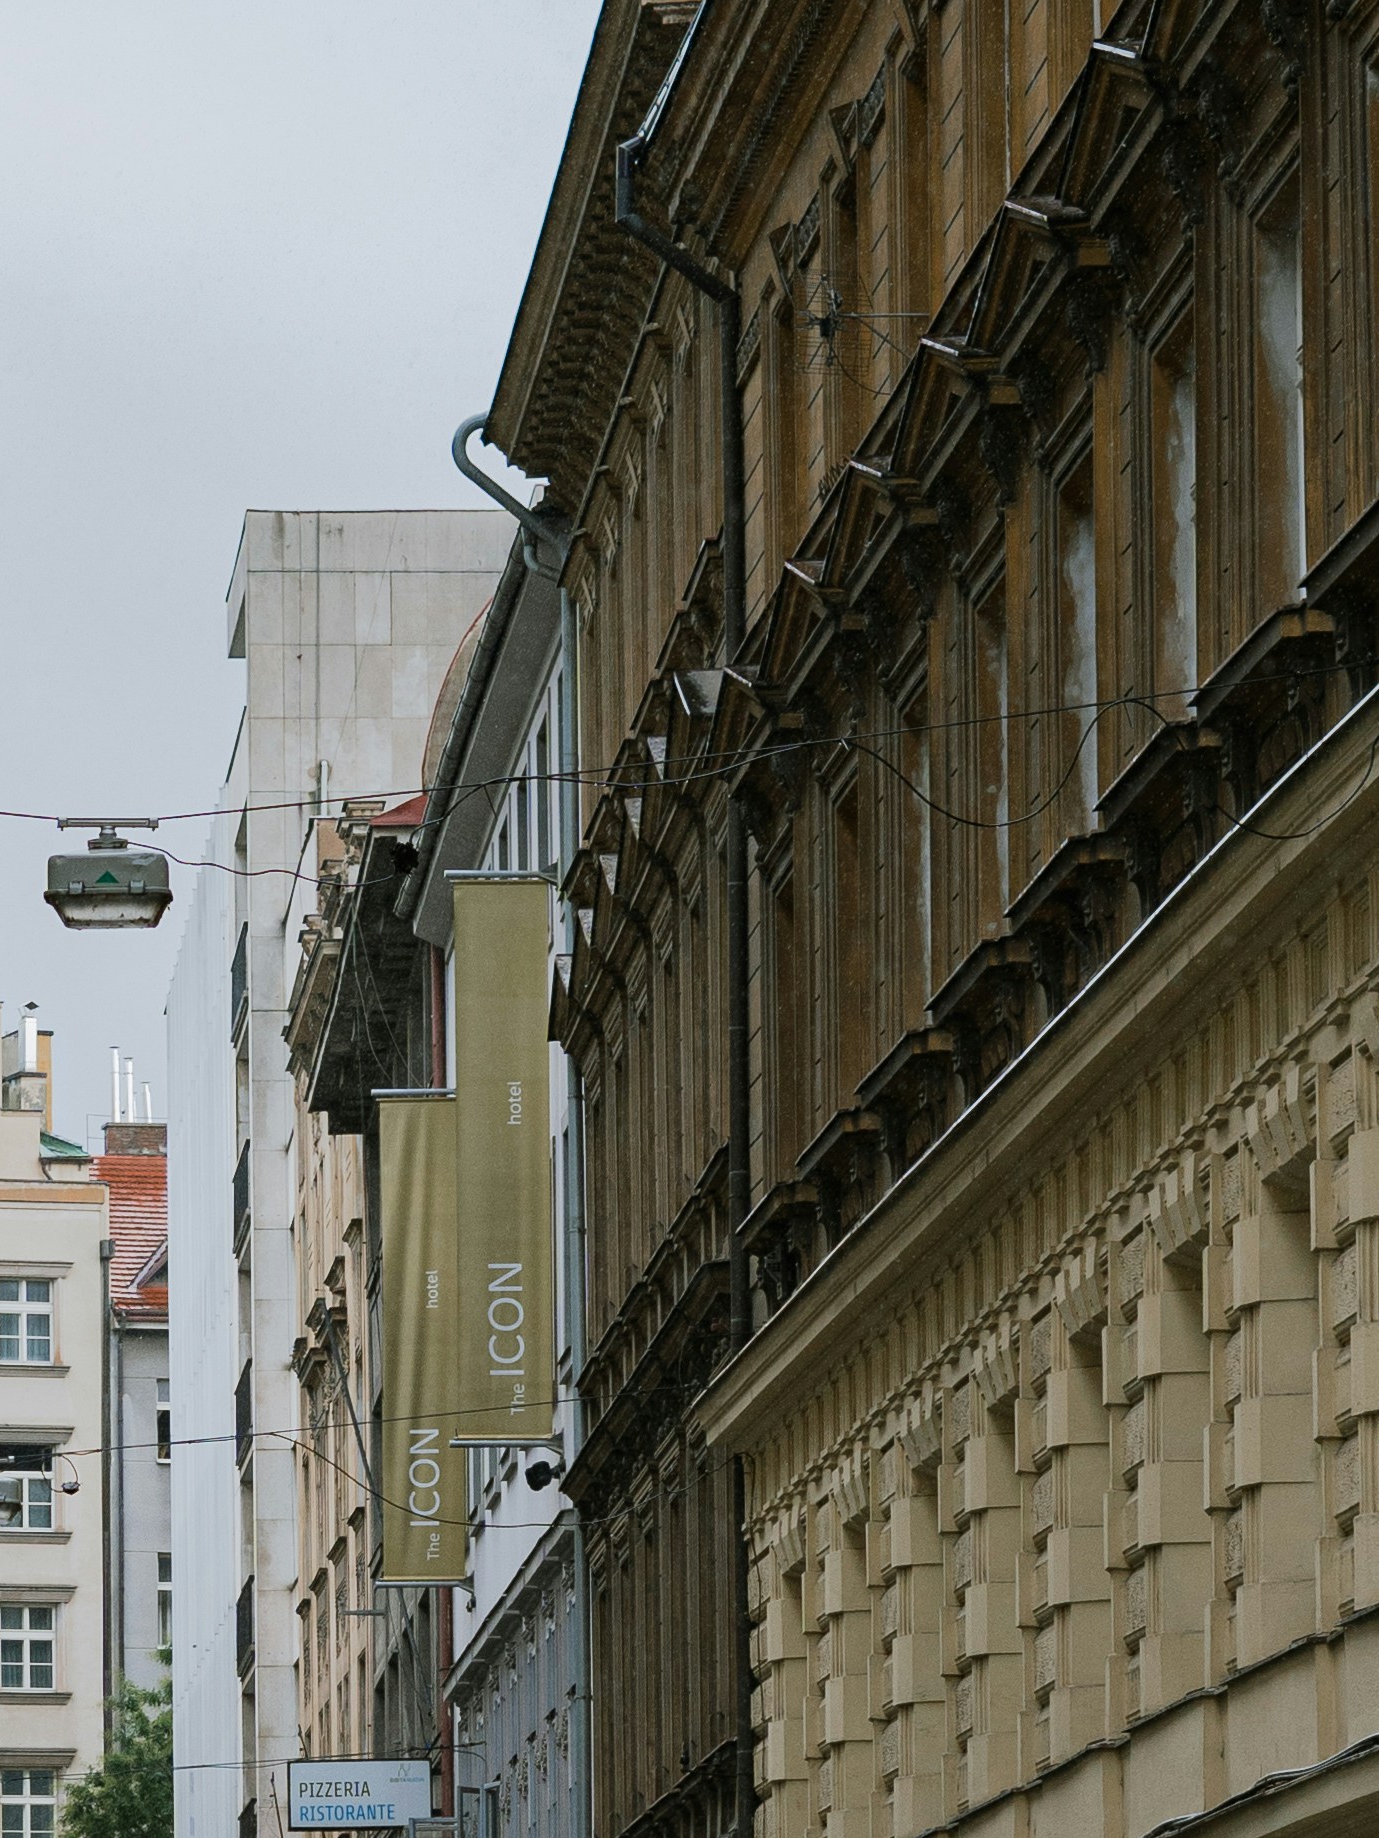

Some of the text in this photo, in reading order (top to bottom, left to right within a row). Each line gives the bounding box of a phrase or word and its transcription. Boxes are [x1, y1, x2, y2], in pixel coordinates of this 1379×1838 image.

[507, 1081, 522, 1125] hotel
[426, 1270, 439, 1308] hotel
[488, 1263, 526, 1416] The ICON
[408, 1428, 441, 1560] The ICON
[299, 1781, 371, 1798] PIZZERIA
[300, 1804, 395, 1821] RISTORANTE
